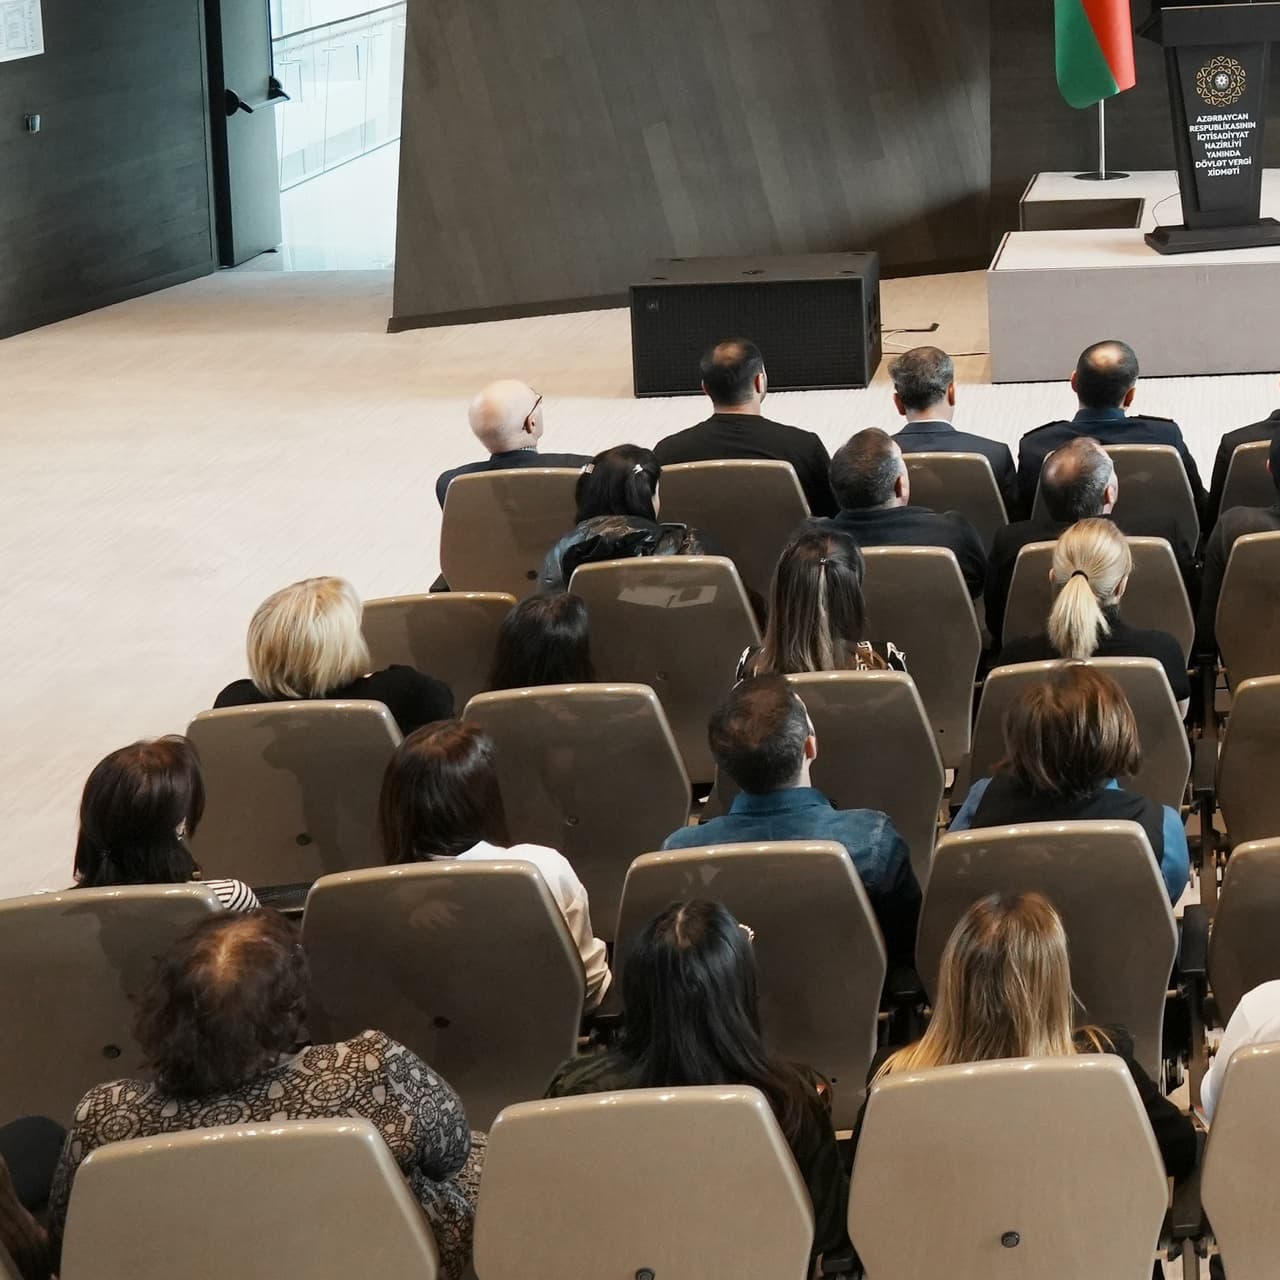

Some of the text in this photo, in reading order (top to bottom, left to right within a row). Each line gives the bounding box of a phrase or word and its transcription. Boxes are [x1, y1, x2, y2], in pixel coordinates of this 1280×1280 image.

[1196, 113, 1249, 123] AZƏRBAYCAN
[1189, 122, 1256, 132] RESPUBLİKASININ
[1204, 139, 1242, 149] NAZİRLİYİ
[1206, 150, 1241, 158] YANINDA
[1195, 156, 1252, 168] DÖVLƏT VERGİ
[1207, 167, 1240, 177] XİDMƏTİ
